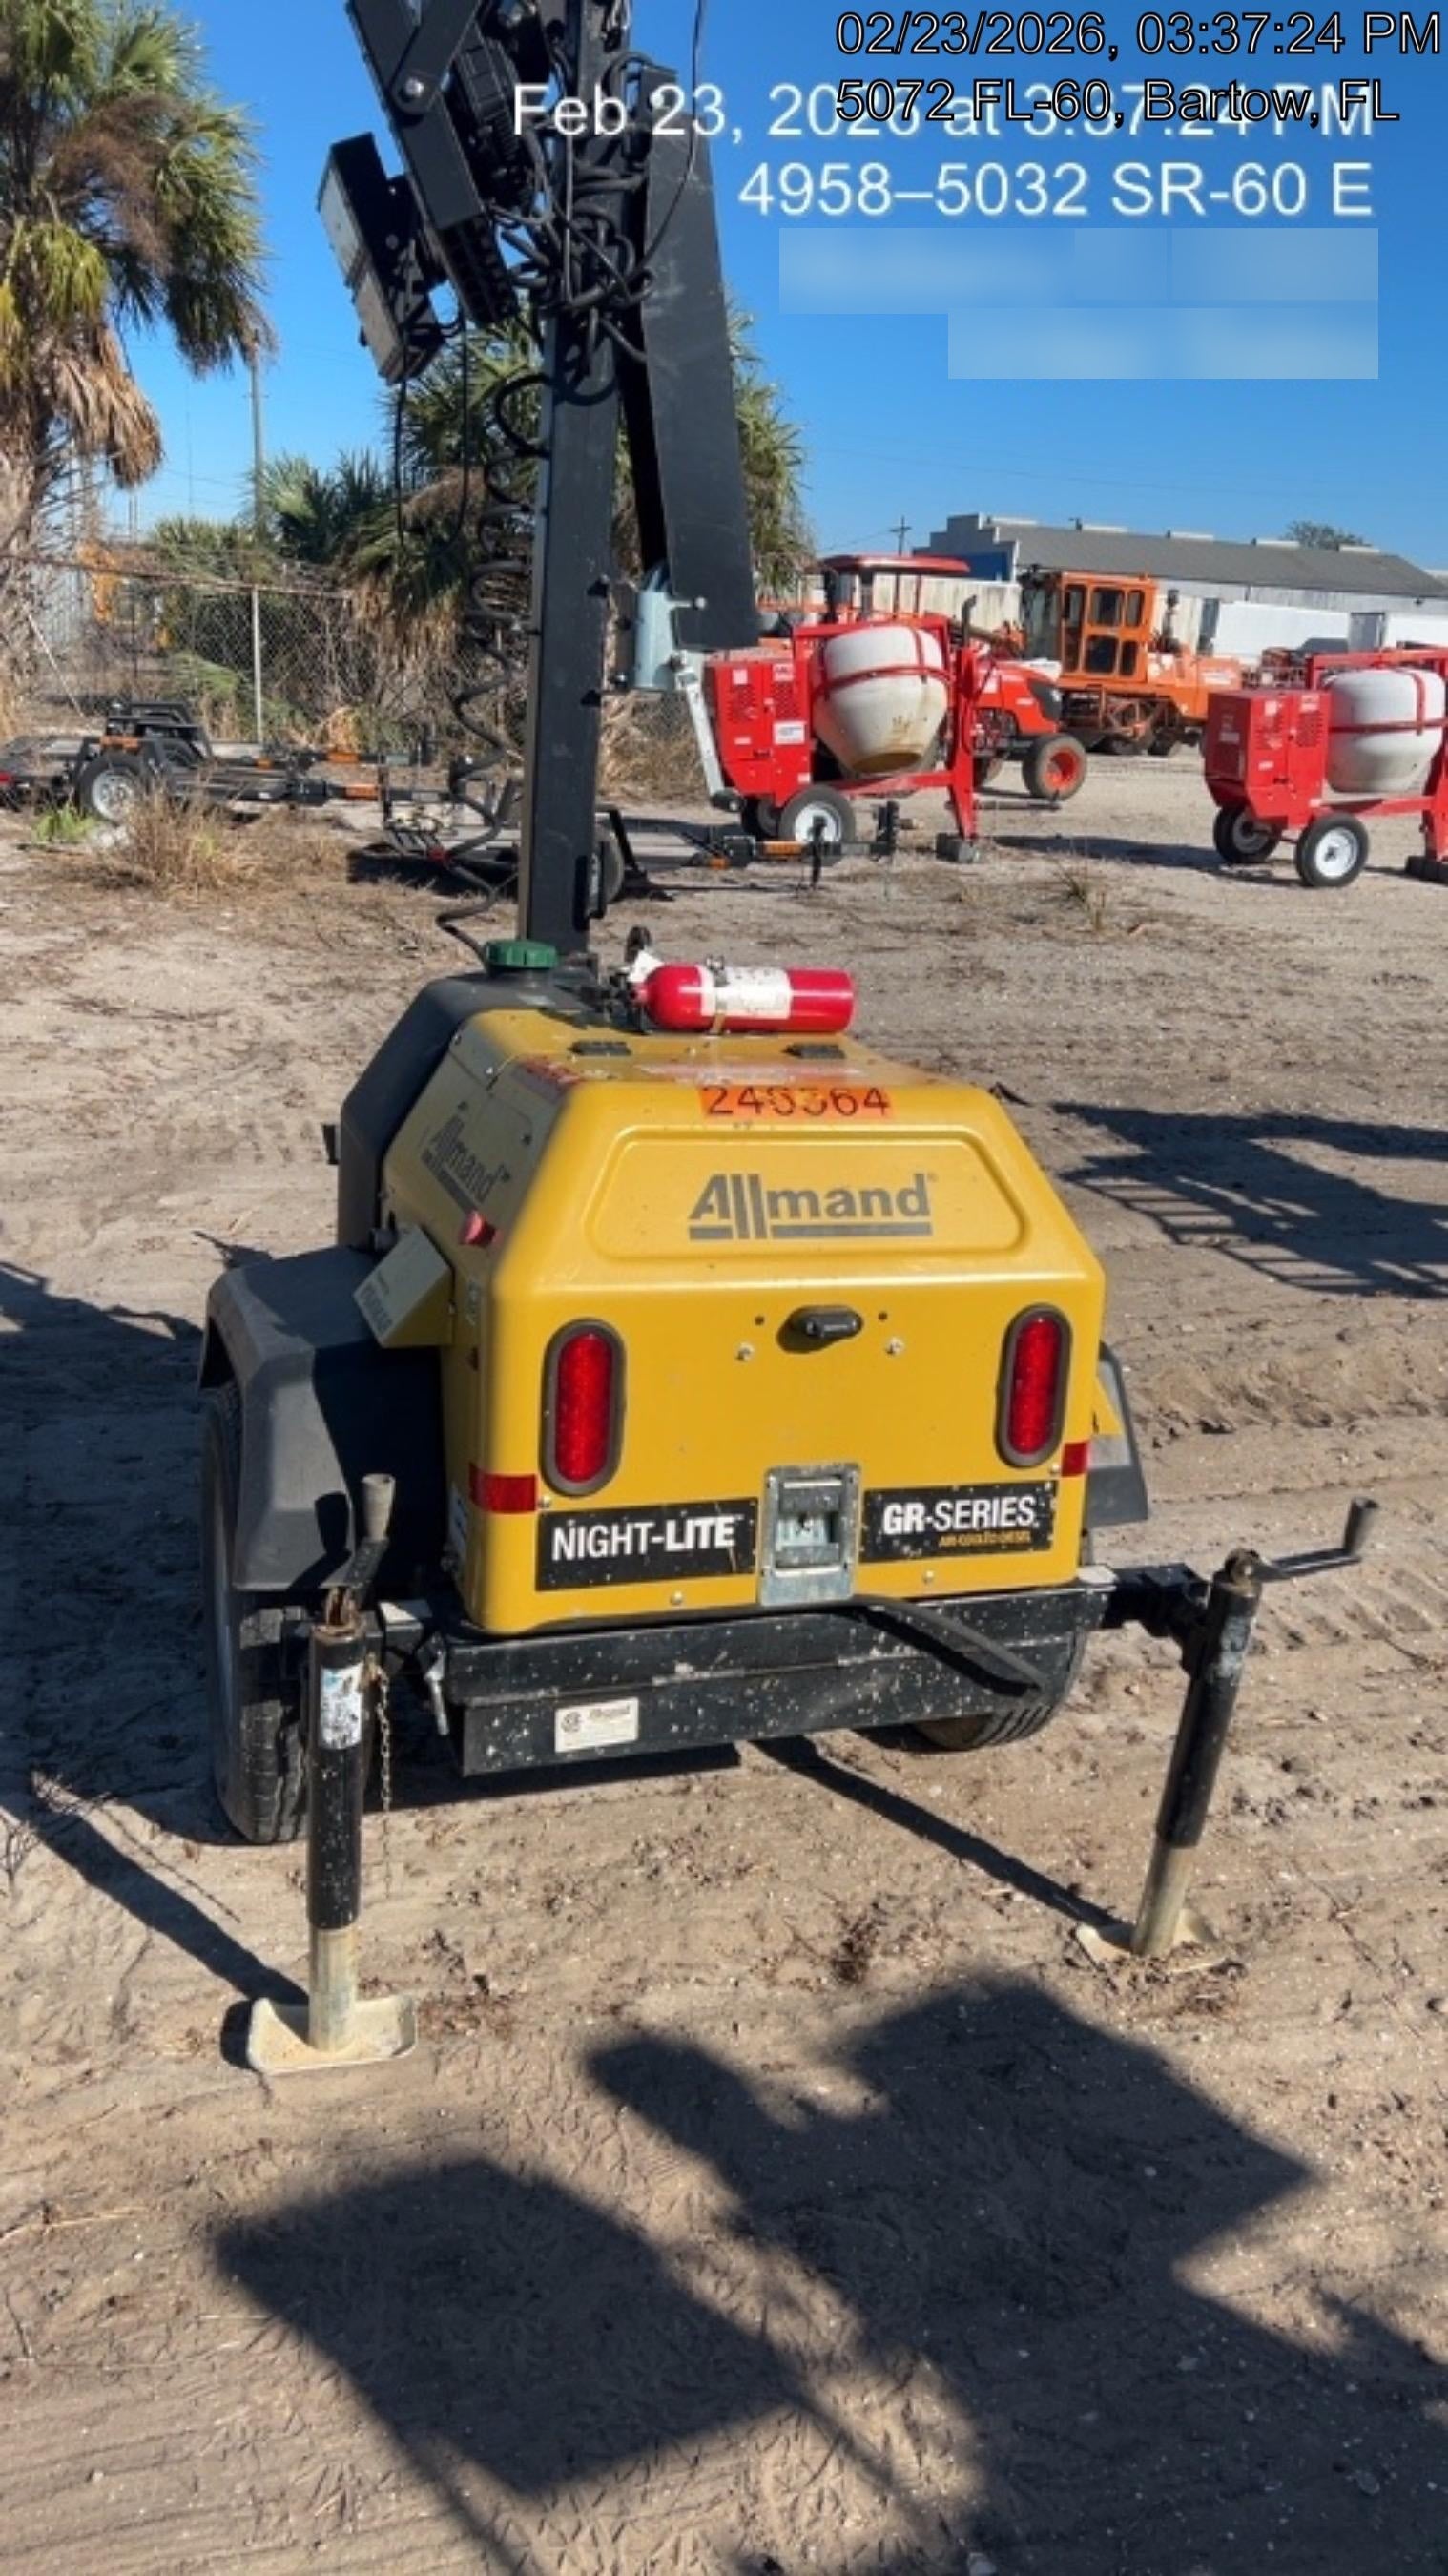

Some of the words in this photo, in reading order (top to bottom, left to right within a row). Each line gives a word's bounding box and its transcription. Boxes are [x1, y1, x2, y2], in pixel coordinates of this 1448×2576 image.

[427, 1112, 507, 1204] Allmand
[688, 1173, 932, 1241] Allmand
[551, 1513, 737, 1562] NIGHT-LITE
[882, 1495, 1036, 1535] GR-SERIES
